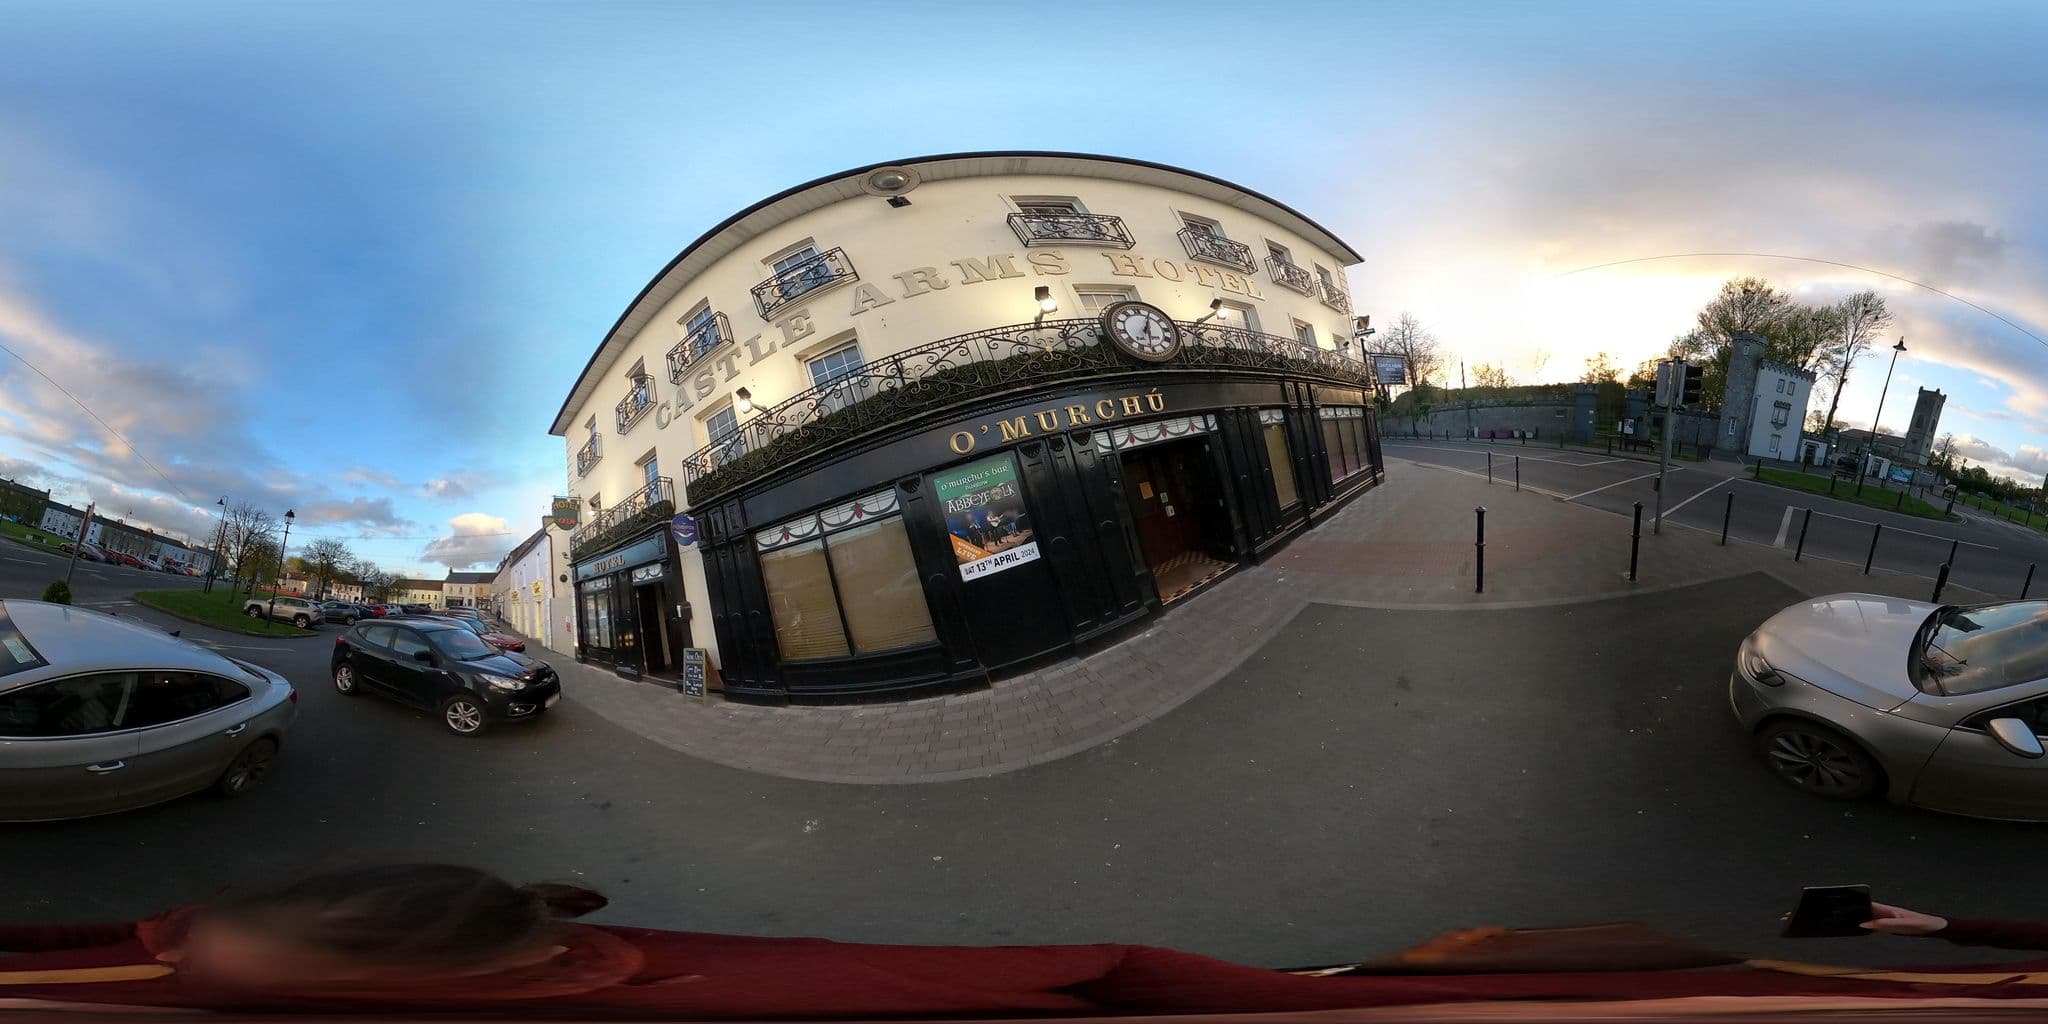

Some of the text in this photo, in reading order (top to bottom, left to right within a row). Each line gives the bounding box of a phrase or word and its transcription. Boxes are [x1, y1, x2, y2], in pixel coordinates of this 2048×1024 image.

[655, 248, 1265, 430] CASTLE ARMS HOTEL
[950, 388, 1165, 454] O'MURCHÚ
[994, 552, 1021, 568] APRIL
[1020, 548, 1035, 558] 2024
